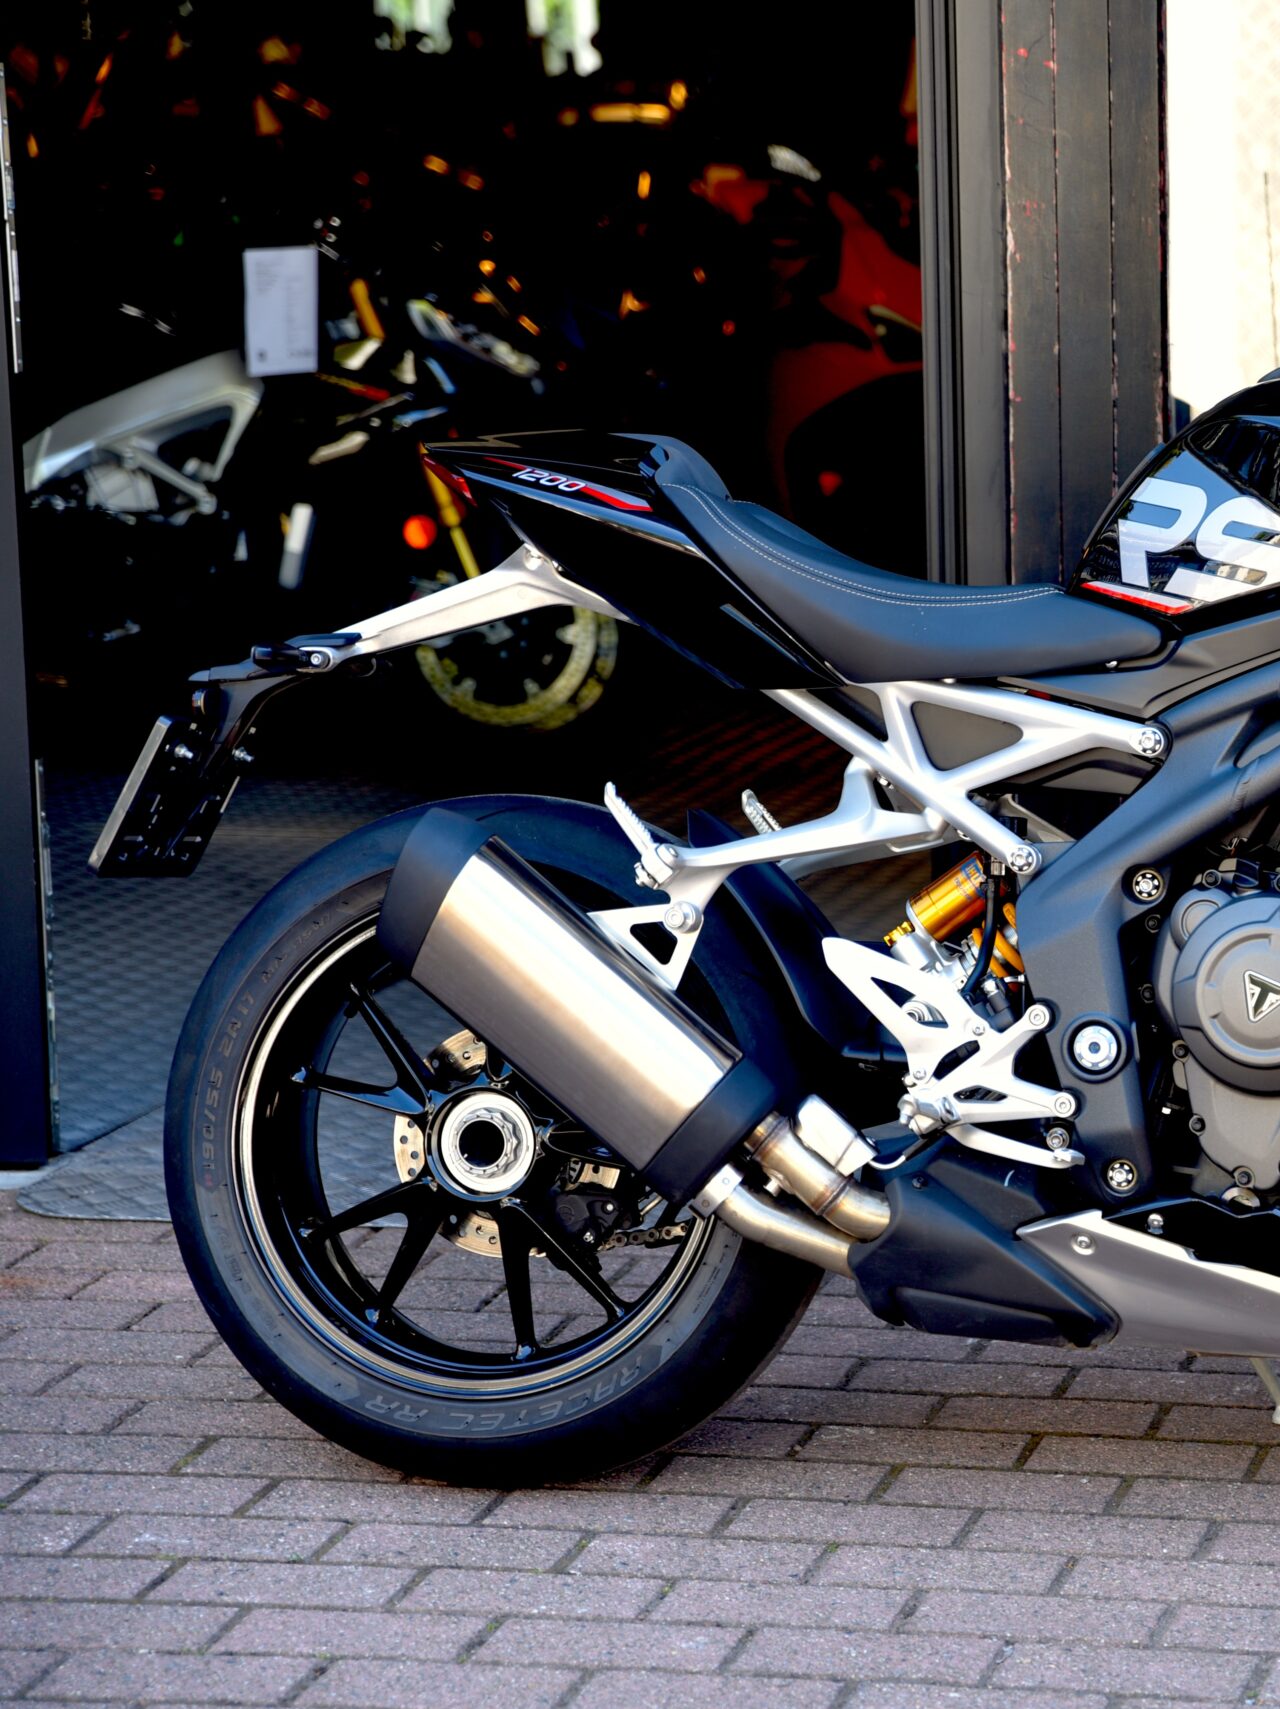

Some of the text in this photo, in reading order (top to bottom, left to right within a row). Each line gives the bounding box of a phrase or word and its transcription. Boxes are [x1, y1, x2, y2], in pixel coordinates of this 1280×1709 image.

[511, 467, 586, 492] 1200
[364, 1354, 644, 1431] RACETEC RR
